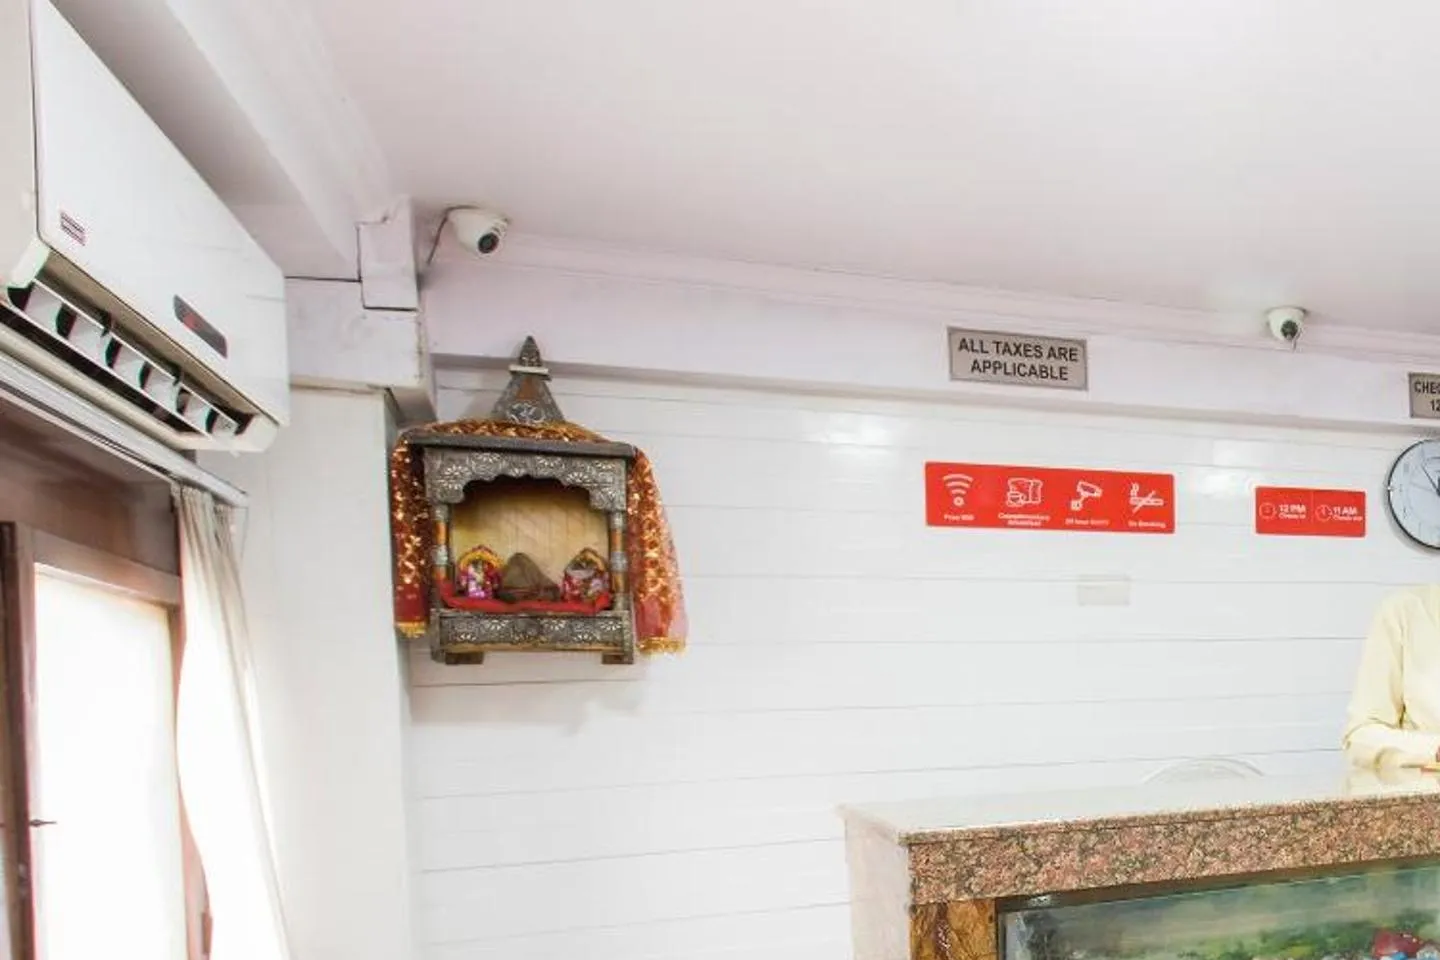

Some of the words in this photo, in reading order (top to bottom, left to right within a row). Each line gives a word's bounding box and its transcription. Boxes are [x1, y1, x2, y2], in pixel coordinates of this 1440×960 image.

[958, 338, 989, 354] ALL
[992, 341, 1043, 359] TAXES
[1046, 346, 1079, 362] ARE
[971, 359, 1069, 381] APPLICABLE
